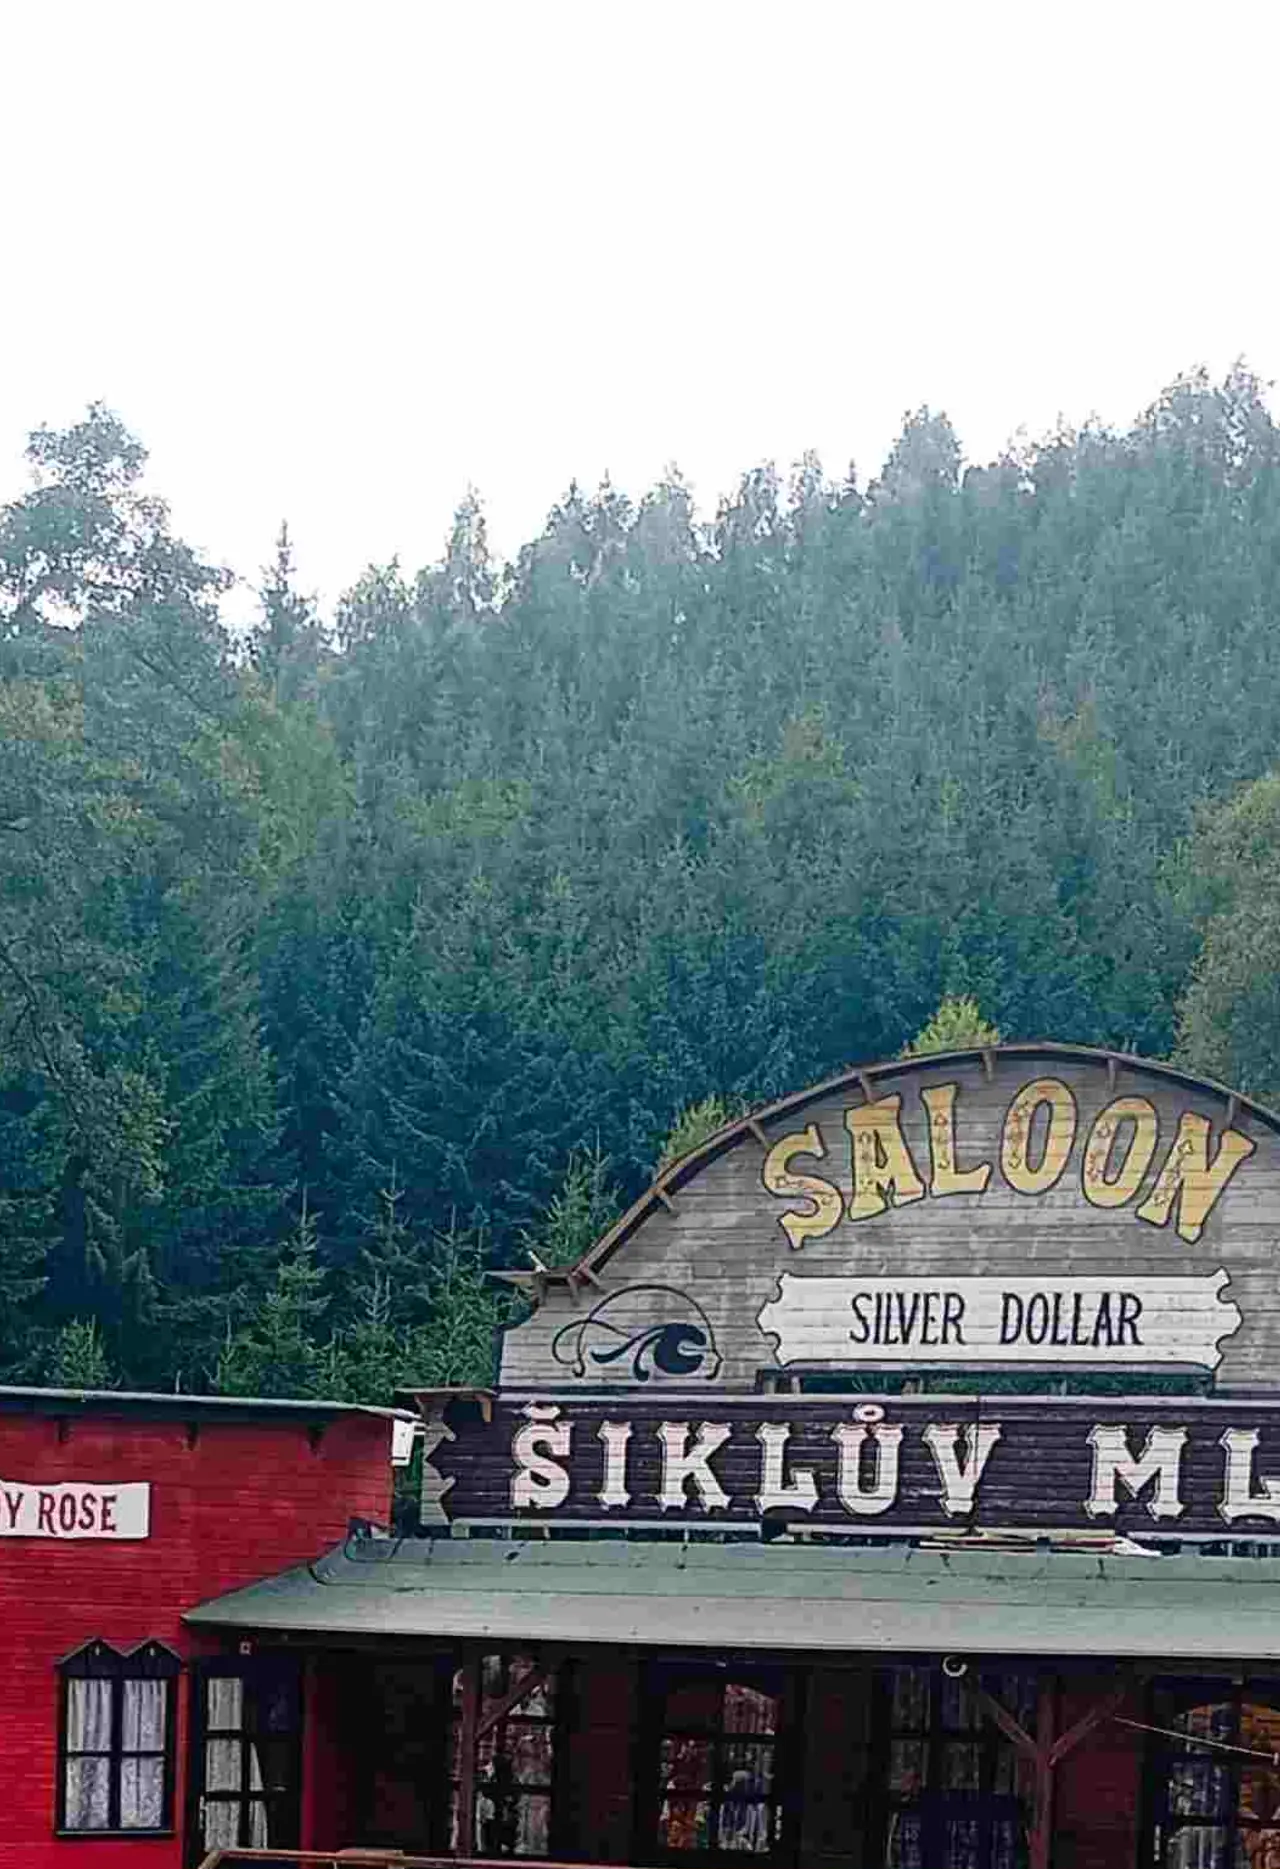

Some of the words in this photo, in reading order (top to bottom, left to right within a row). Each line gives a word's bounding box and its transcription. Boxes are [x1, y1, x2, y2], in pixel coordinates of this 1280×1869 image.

[762, 1077, 1257, 1250] SALOON
[849, 1290, 966, 1346] SILVER
[1000, 1290, 1145, 1347] DOLLAR
[510, 1402, 1003, 1518] ŠIKLŮV
[37, 1491, 118, 1535] ROSE
